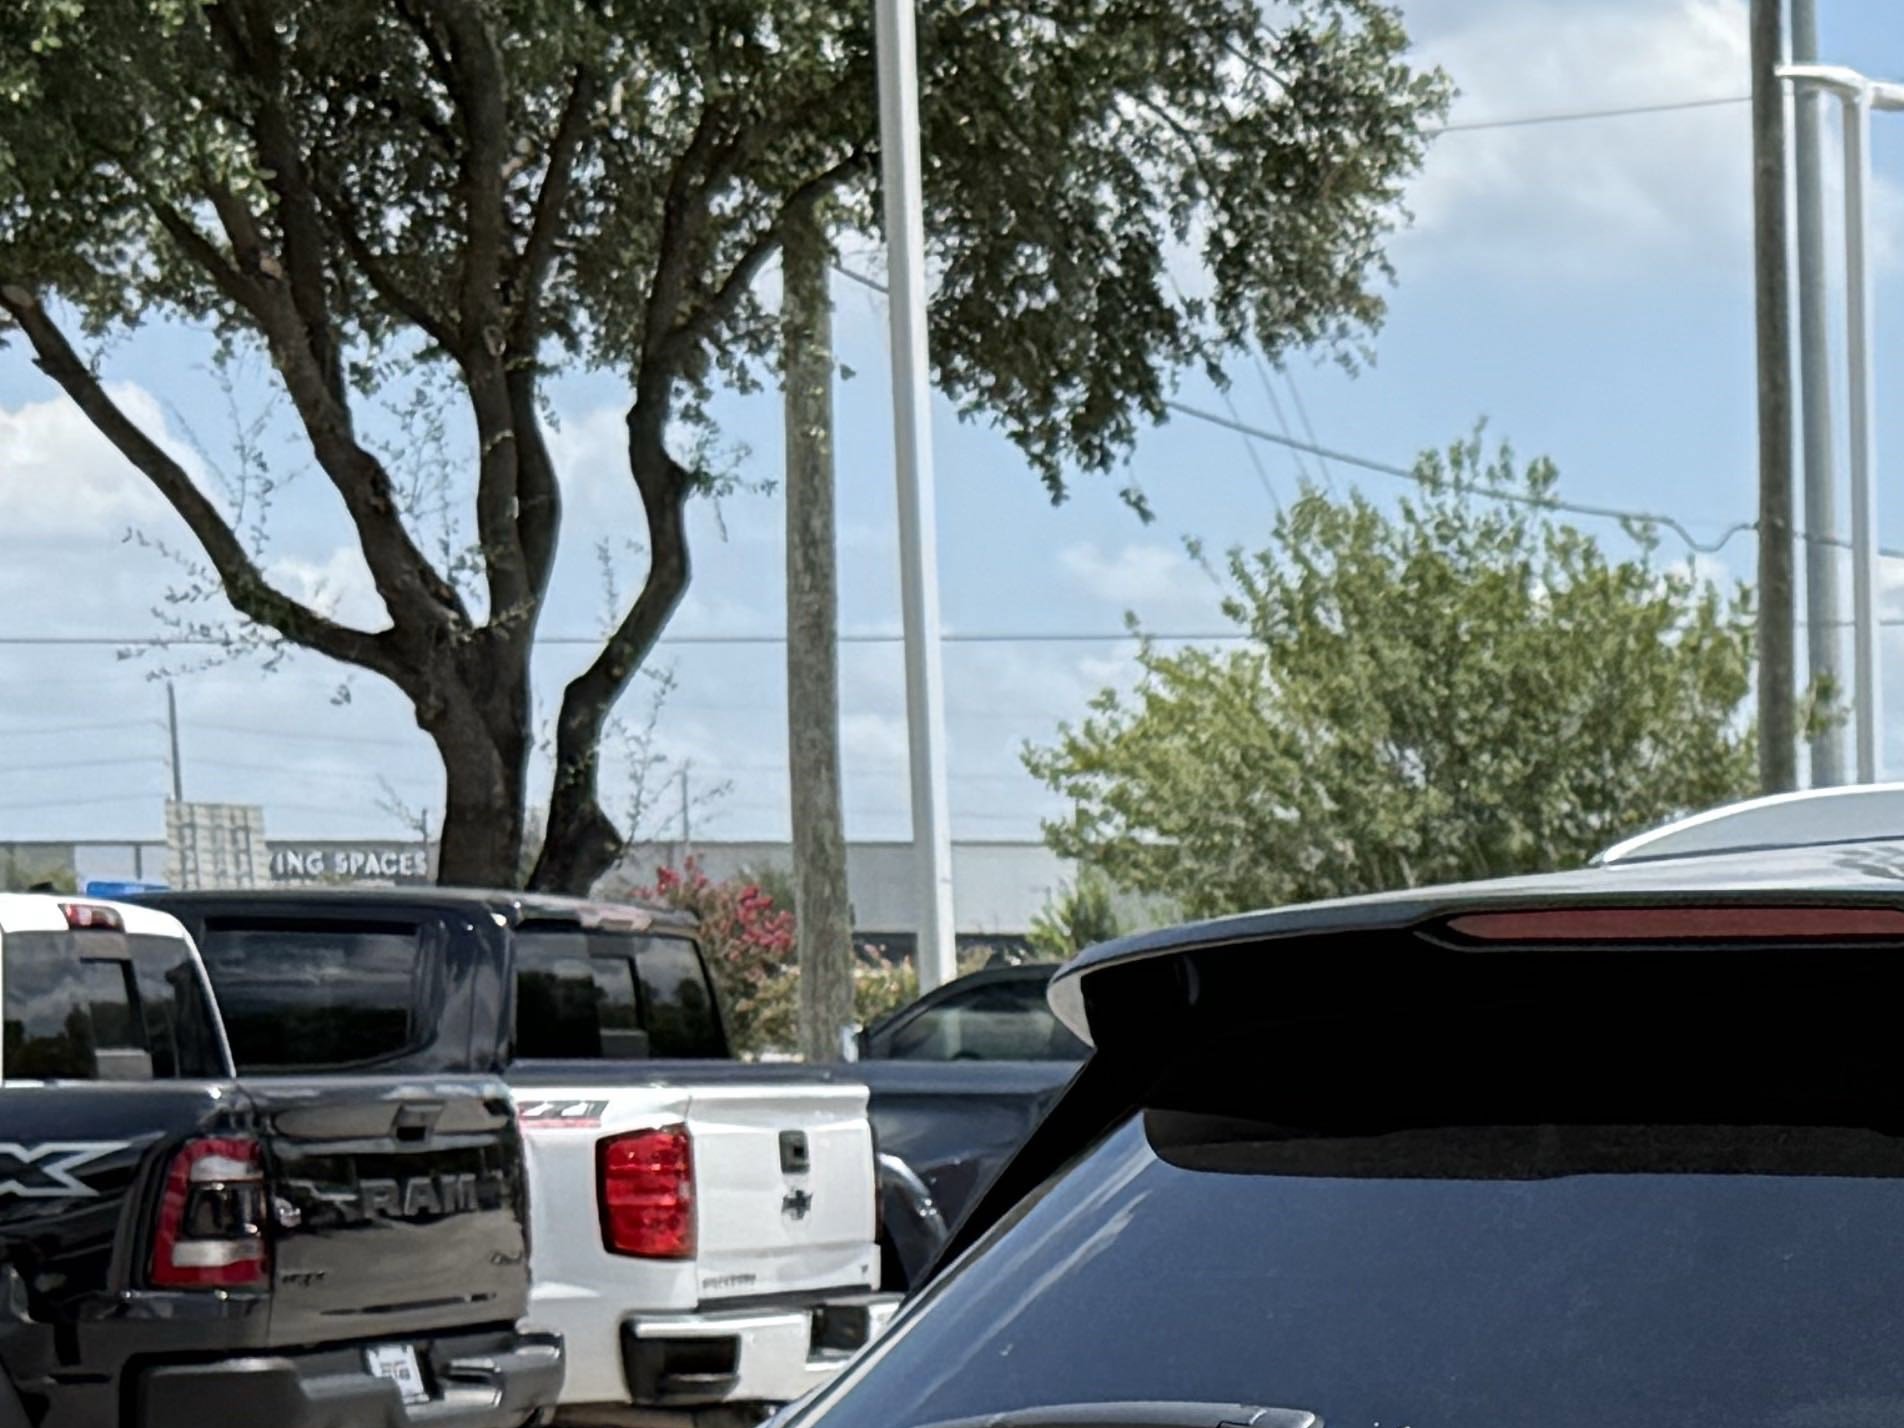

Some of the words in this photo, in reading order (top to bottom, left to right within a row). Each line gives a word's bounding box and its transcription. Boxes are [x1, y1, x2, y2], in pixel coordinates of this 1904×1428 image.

[270, 850, 324, 876] ING
[335, 850, 428, 876] SPACES
[360, 1173, 478, 1217] RAM
